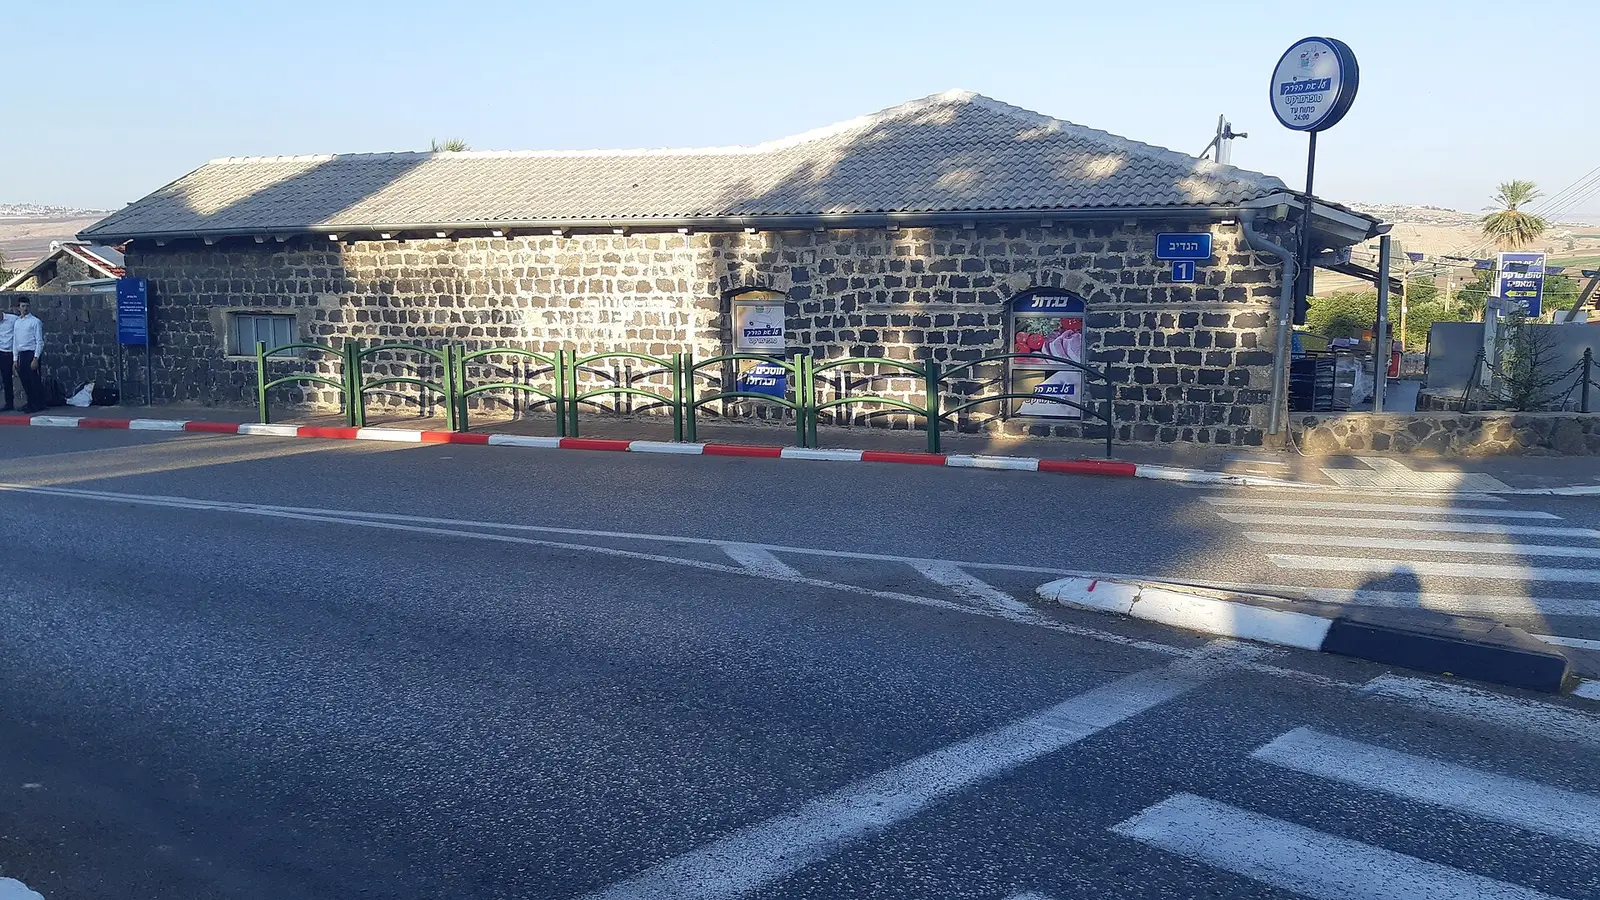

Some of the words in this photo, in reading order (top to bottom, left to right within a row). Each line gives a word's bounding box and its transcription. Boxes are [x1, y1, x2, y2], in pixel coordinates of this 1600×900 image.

[1284, 84, 1304, 95] הדרך
[1305, 82, 1316, 91] אם
[1285, 93, 1323, 106] סופרמרקט
[1169, 242, 1198, 251] הנדיב
[1178, 263, 1187, 279] 1
[1031, 294, 1069, 308] בגדול
[755, 366, 785, 375] חוסכים
[746, 376, 776, 386] ובגדול!
